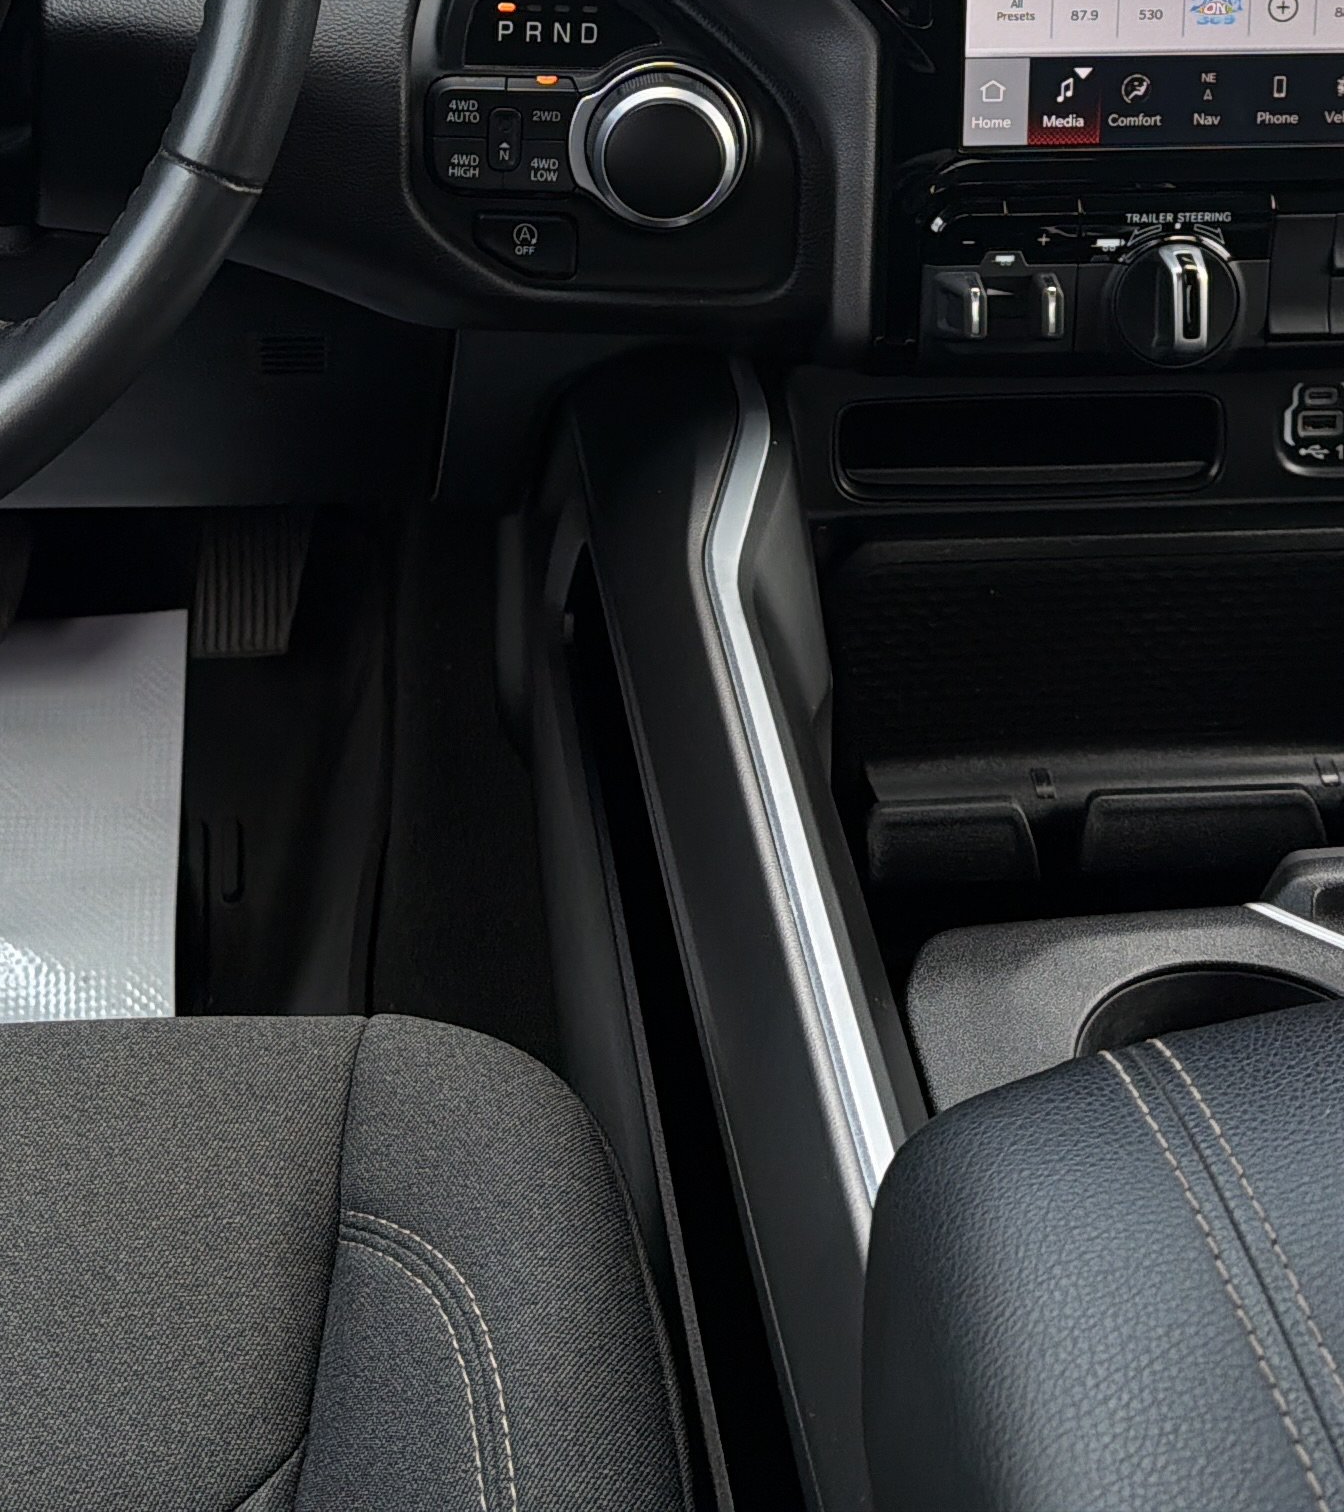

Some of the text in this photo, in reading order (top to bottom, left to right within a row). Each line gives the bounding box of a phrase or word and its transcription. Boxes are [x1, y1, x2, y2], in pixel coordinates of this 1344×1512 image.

[996, 11, 1035, 23] Presets
[1070, 9, 1099, 21] 87.9
[1139, 9, 1163, 20] 530
[498, 21, 598, 44] P R N D
[1201, 73, 1217, 83] NE
[449, 100, 479, 112] 4WD
[446, 111, 480, 123] AUTO
[532, 111, 561, 122] 2WD
[971, 116, 1012, 129] Home
[1042, 114, 1084, 128] Media
[1108, 113, 1162, 128] Comfort
[1193, 112, 1221, 126] Nav
[1256, 111, 1299, 125] Phone
[450, 154, 480, 166] 4WD
[499, 150, 510, 161] N
[530, 158, 559, 170] 4WD
[448, 166, 480, 178] HIGH
[530, 170, 559, 182] LOW
[1125, 211, 1232, 224] TRAILER STEERING
[514, 245, 536, 256] OFF
[1335, 444, 1344, 460] 1
